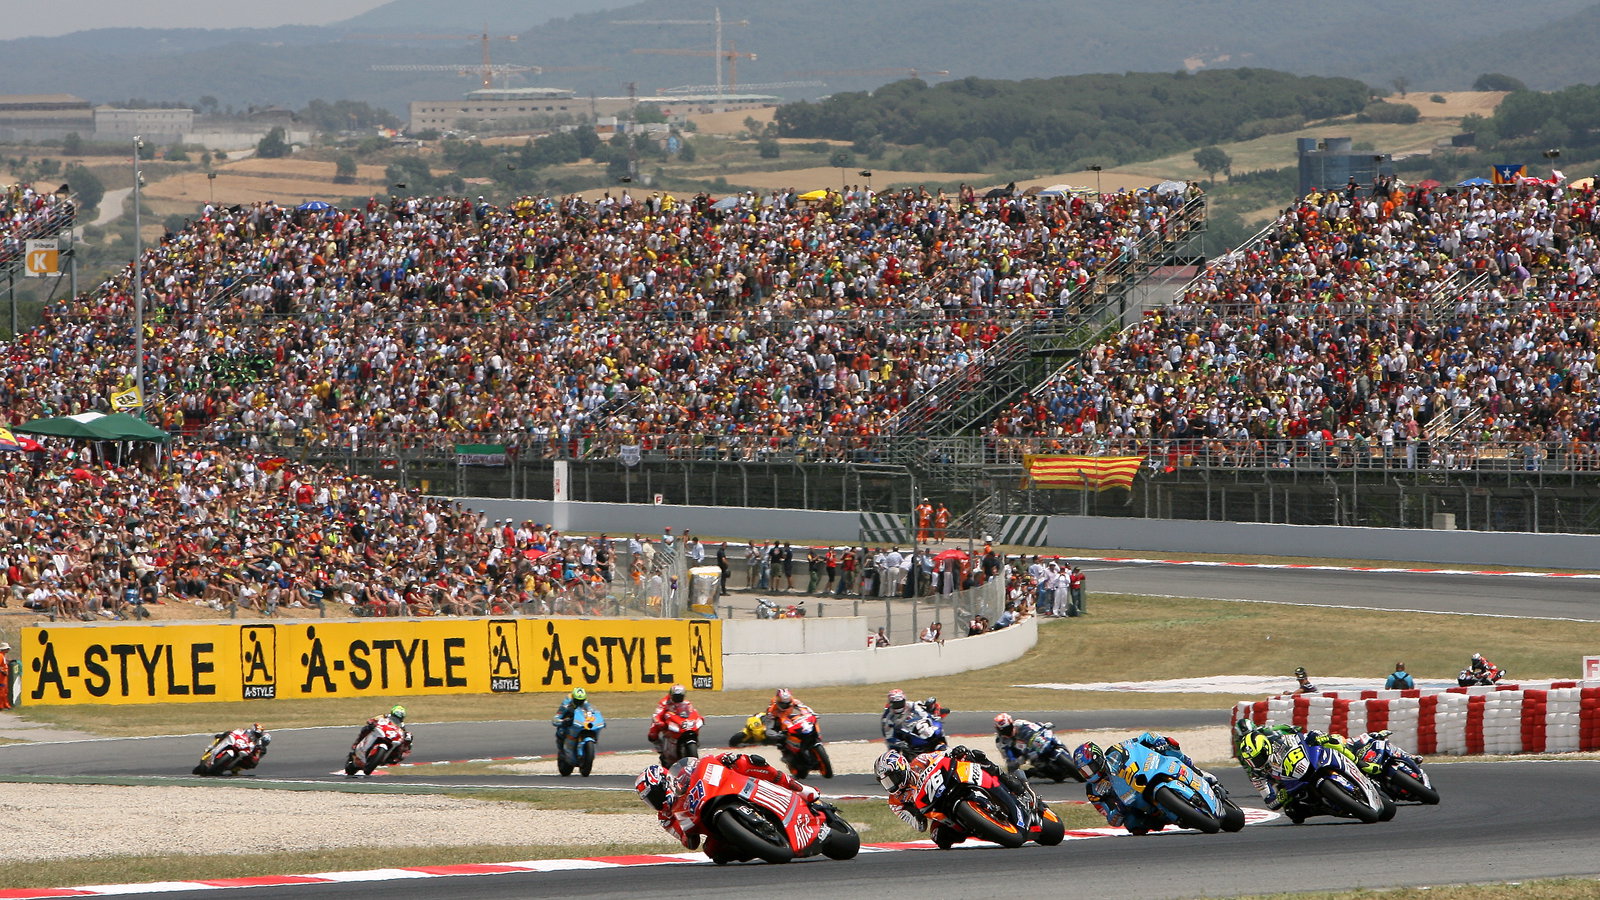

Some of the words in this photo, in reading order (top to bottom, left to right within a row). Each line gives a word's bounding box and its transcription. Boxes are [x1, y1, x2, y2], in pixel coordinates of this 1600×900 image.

[34, 253, 48, 271] K
[542, 622, 673, 685] A-STYLE
[867, 637, 874, 647] F
[32, 630, 215, 699] A-STYLE
[301, 626, 467, 692] A-STYLE
[1587, 660, 1600, 677] F
[245, 687, 274, 697] A-STYLE
[1283, 747, 1305, 777] 46
[688, 779, 706, 815] 27
